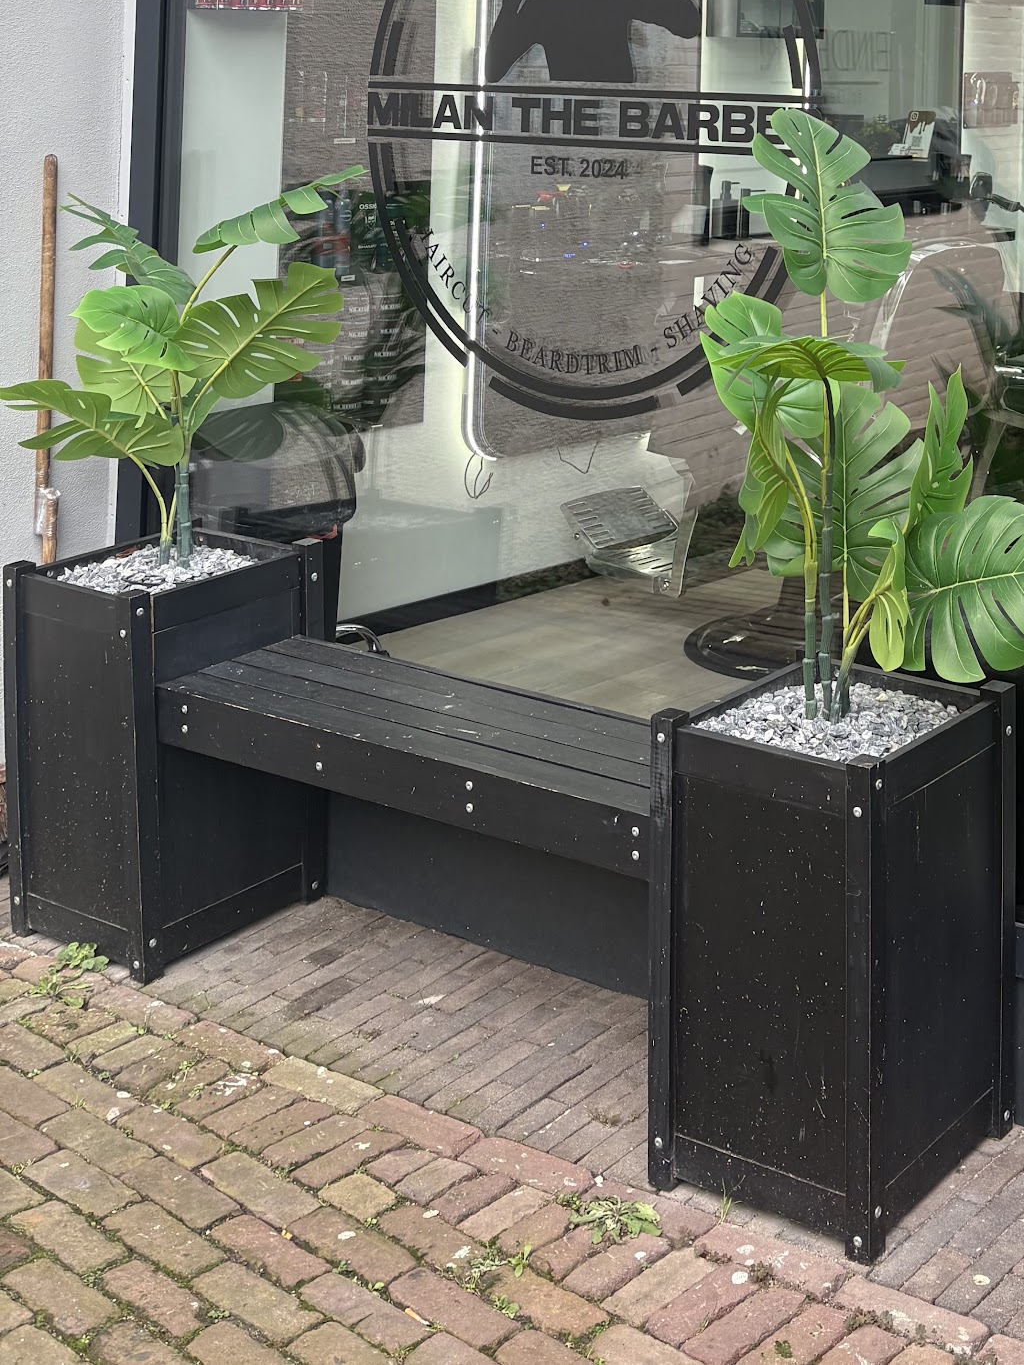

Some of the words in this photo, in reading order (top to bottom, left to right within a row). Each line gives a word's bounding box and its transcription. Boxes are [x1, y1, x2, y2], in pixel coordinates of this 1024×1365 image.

[367, 92, 494, 132] MILAN
[511, 97, 600, 136] THE
[531, 155, 572, 177] EST.
[580, 159, 629, 180] 2024
[505, 330, 642, 375] BEARDTRIM
[663, 243, 752, 349] SHAVING
